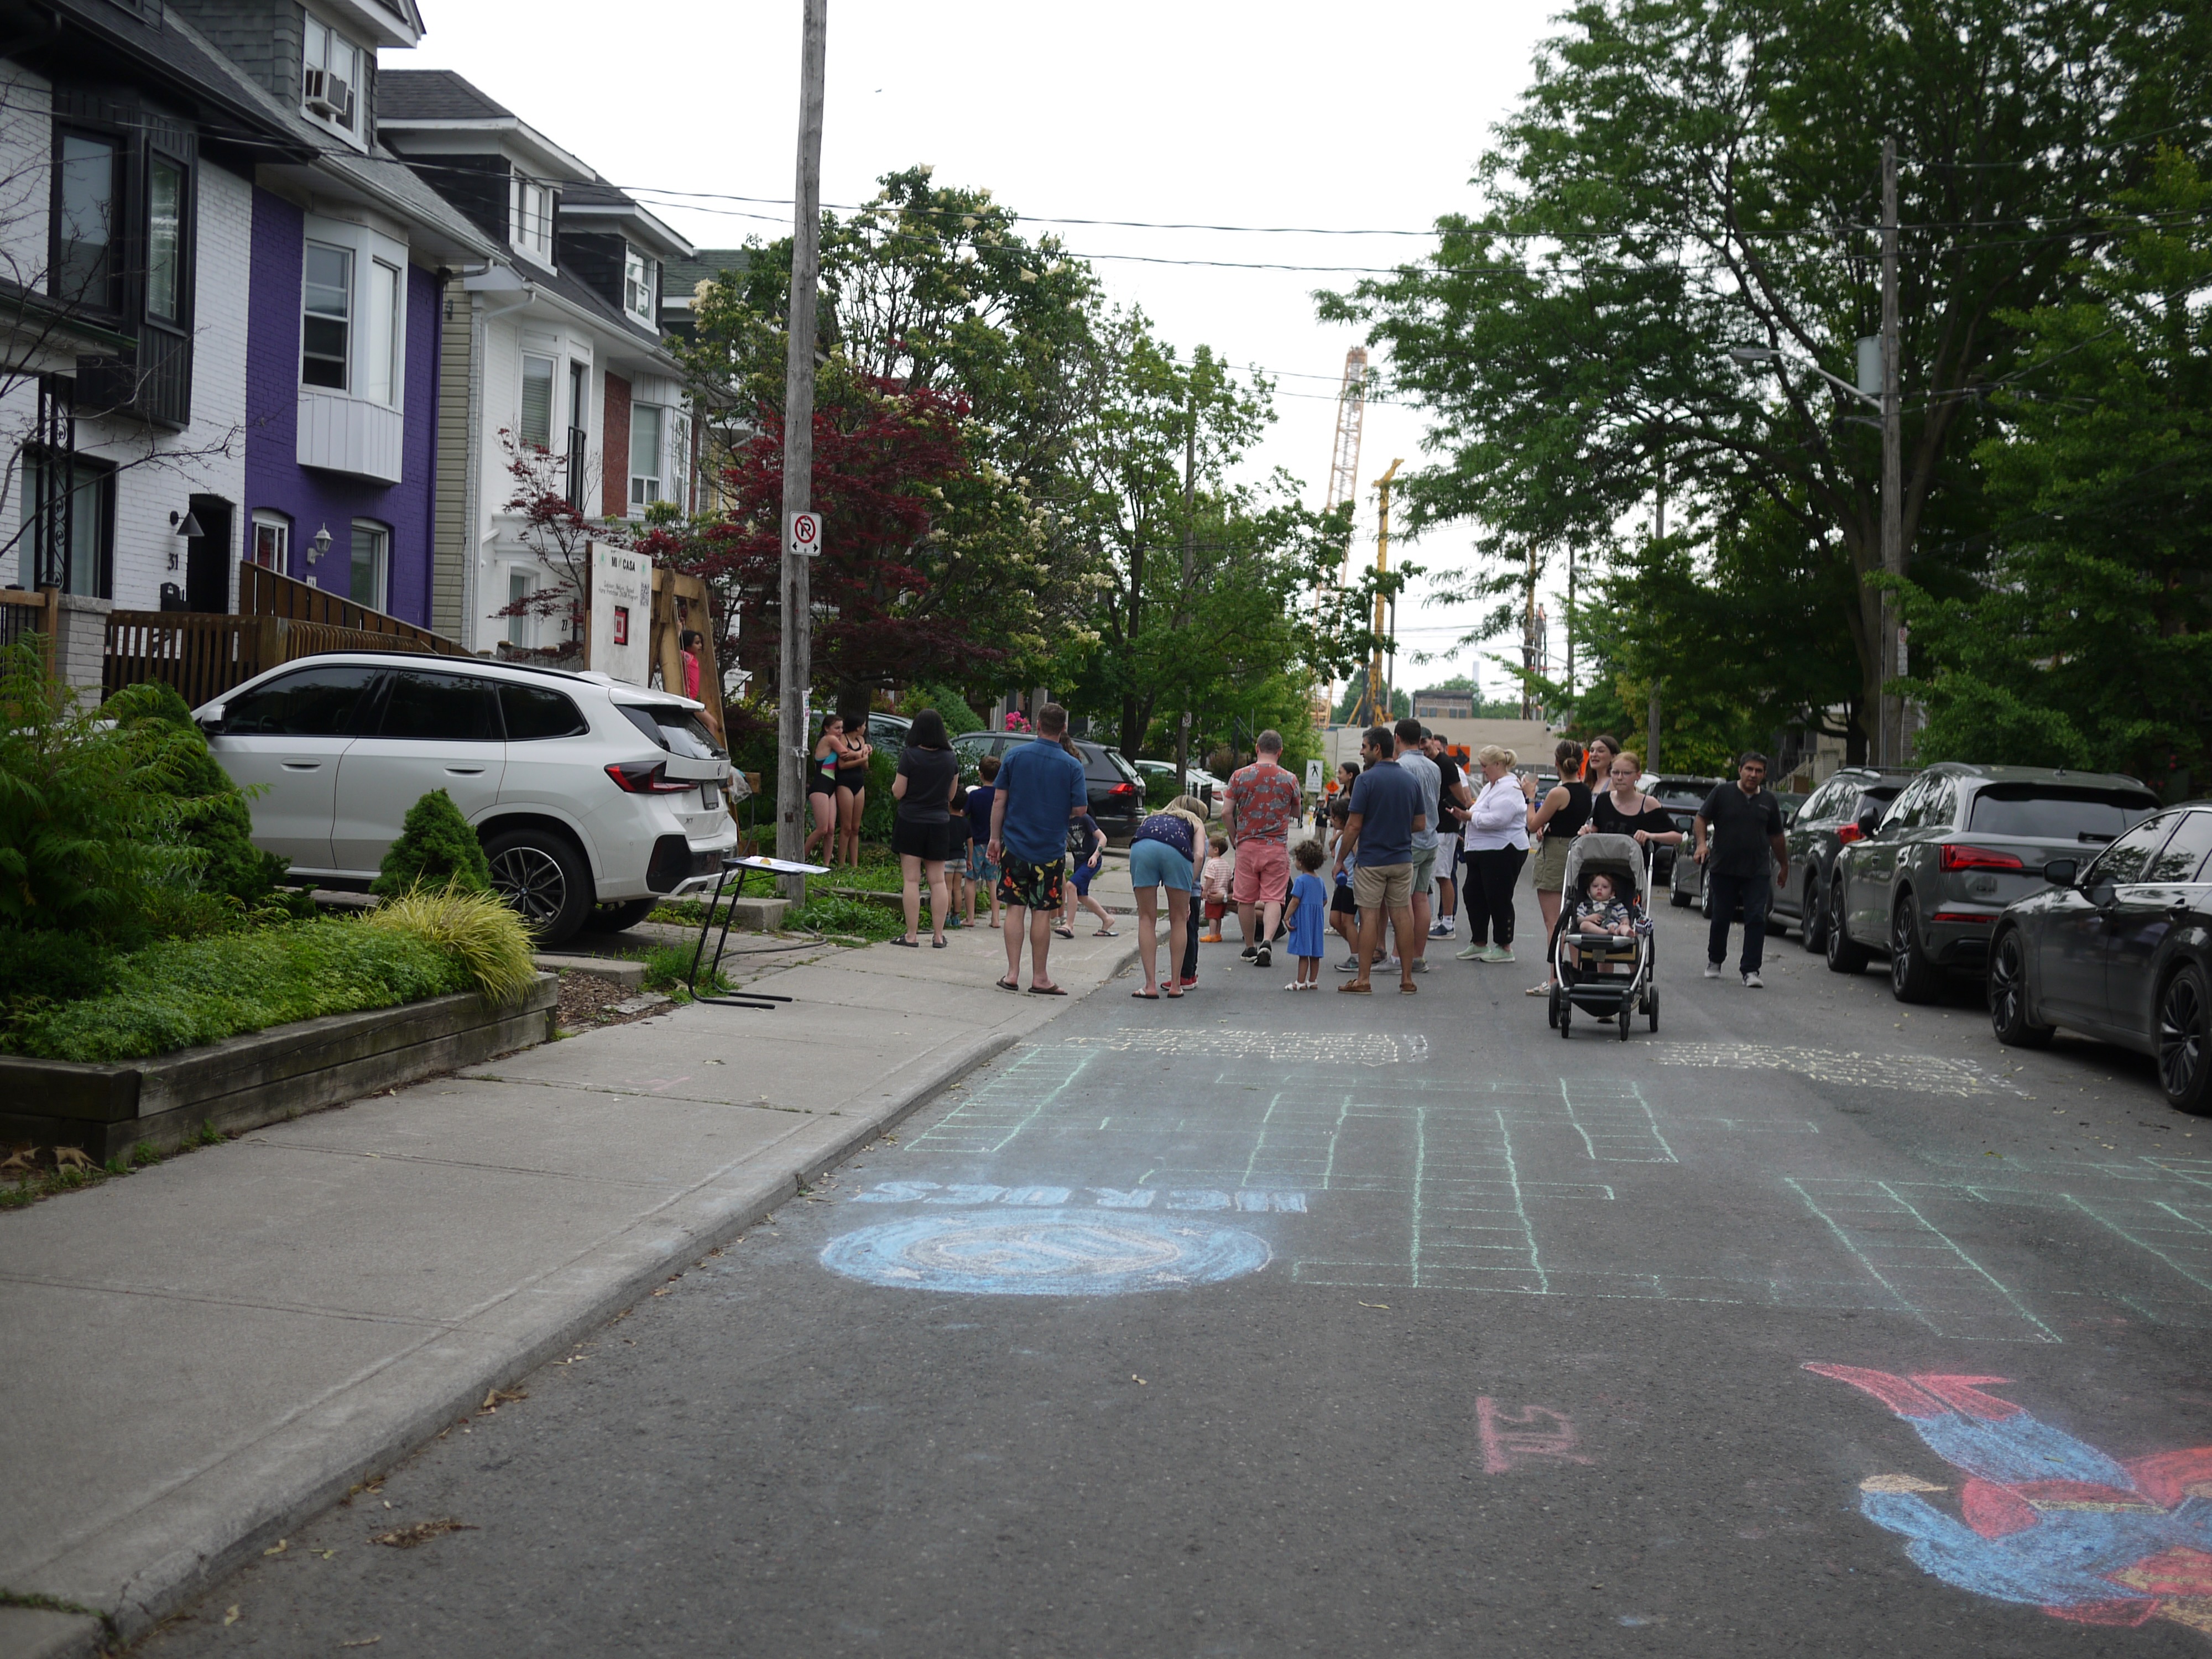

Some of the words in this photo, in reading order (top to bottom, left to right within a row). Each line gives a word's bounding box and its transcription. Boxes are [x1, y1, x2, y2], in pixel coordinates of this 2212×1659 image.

[167, 553, 178, 571] 31
[611, 556, 618, 567] MI
[623, 559, 635, 572] CASA
